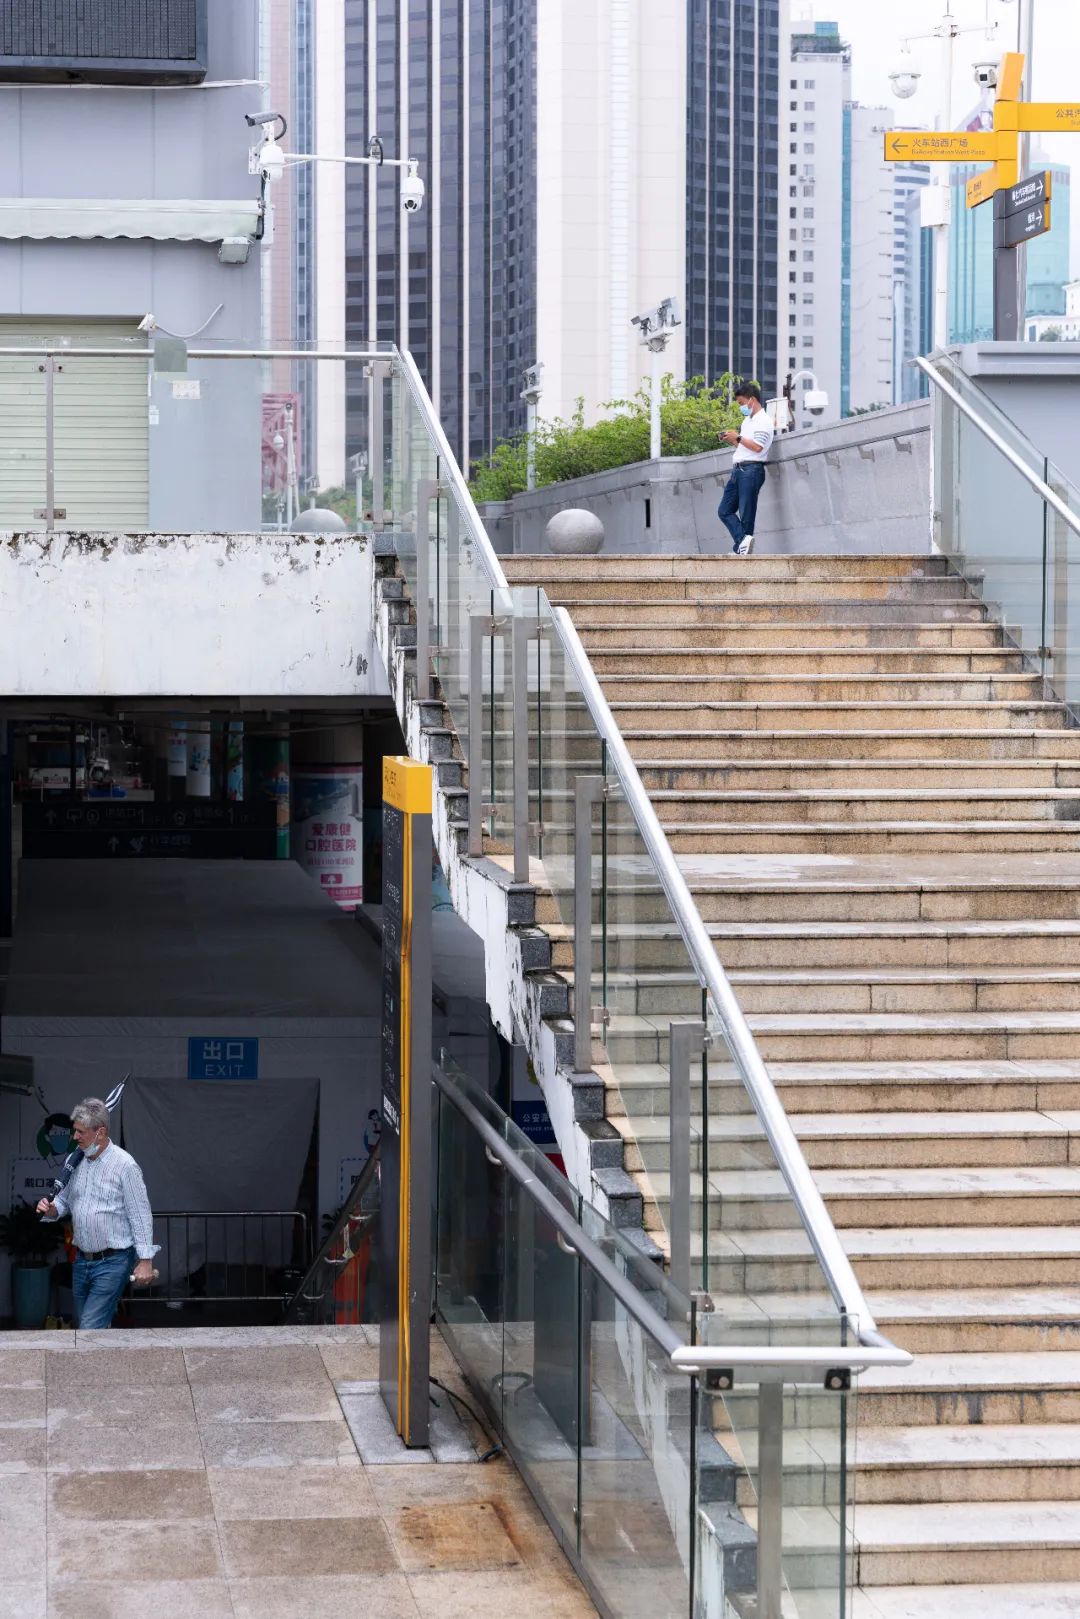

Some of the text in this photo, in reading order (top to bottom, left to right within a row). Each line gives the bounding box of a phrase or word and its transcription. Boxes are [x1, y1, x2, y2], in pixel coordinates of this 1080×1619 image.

[912, 138, 968, 148] 火车站西广场
[311, 823, 352, 836] 爱康健
[305, 838, 357, 852] 口腔医院
[202, 1040, 244, 1061] 出口
[204, 1063, 244, 1076] EXIT
[24, 1177, 56, 1188] 戴口罩
